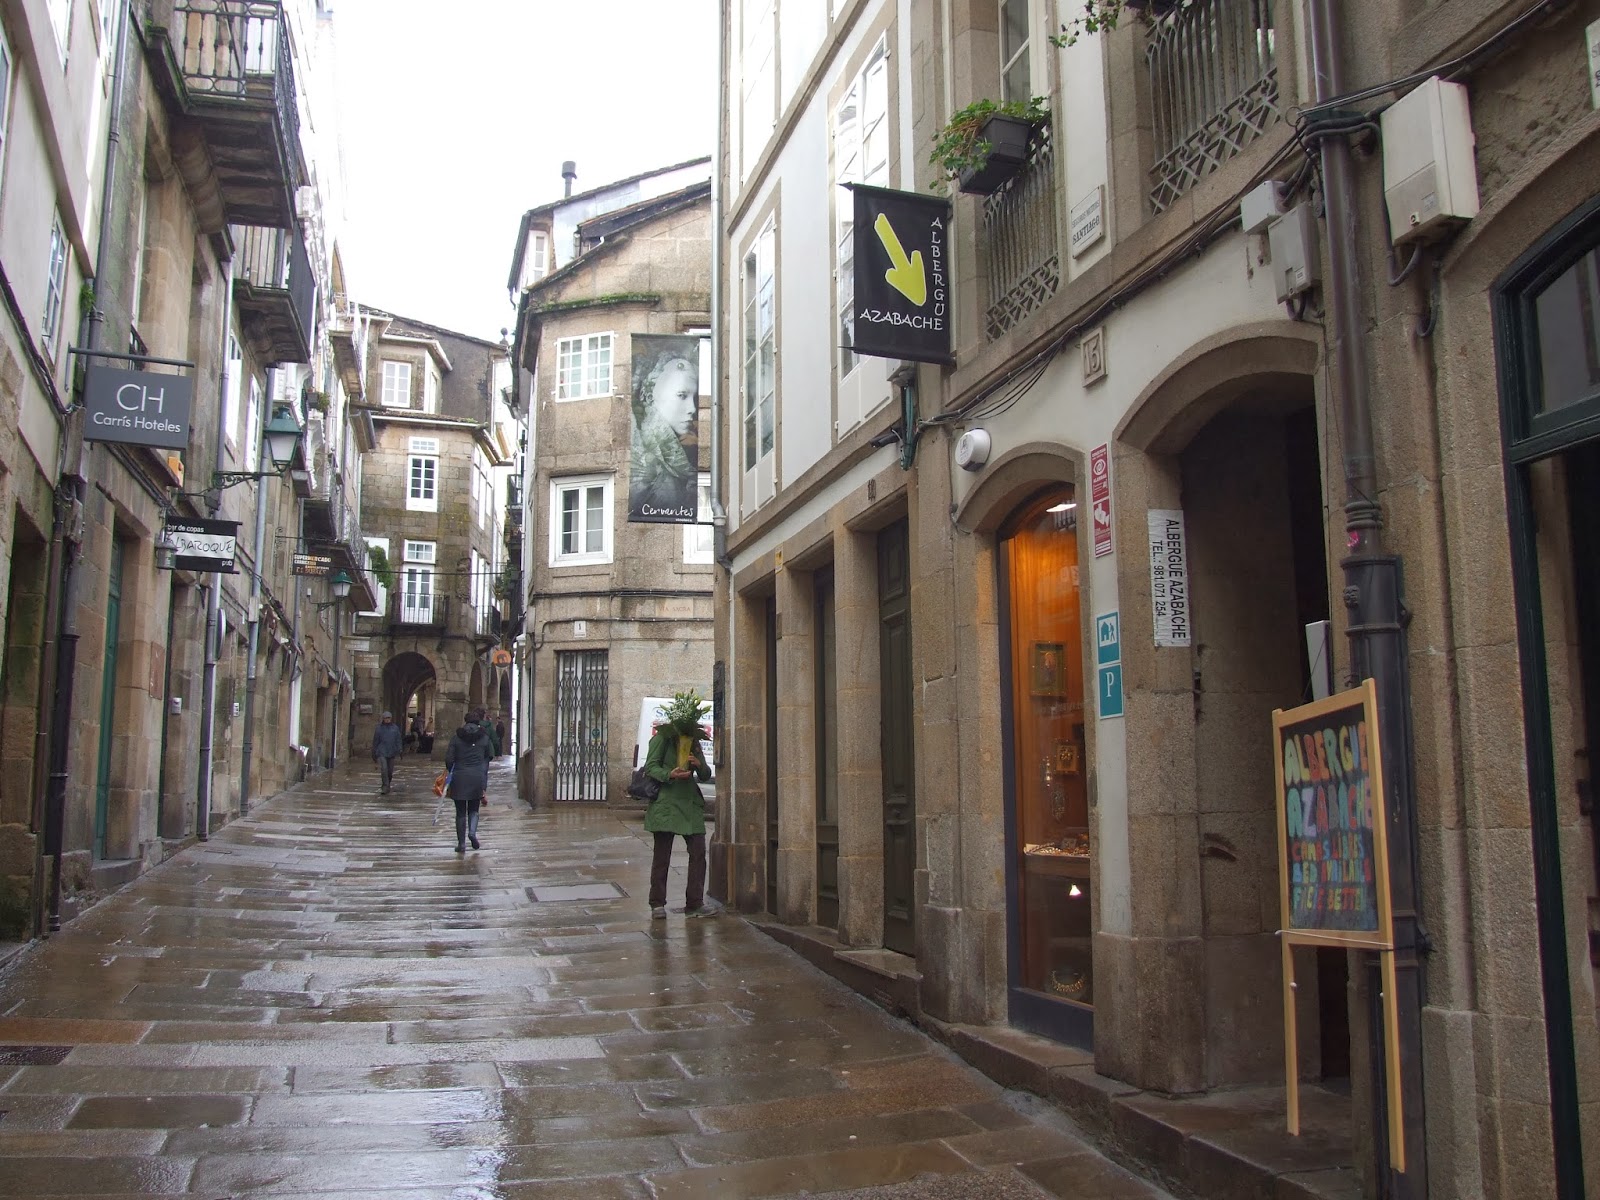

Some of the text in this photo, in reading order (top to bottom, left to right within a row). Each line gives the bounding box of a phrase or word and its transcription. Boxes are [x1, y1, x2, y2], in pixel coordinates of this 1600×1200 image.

[1072, 215, 1100, 245] SANTIAGO
[930, 216, 945, 331] ALBERGUE
[859, 308, 944, 331] AZABACHE
[1084, 335, 1101, 375] 15
[116, 383, 165, 414] CH
[93, 412, 181, 433] Carrís Hoteles
[1153, 565, 1165, 581] 981
[1165, 518, 1186, 639] ALBERGUE AZABACHE
[1154, 584, 1166, 598] 071
[1155, 601, 1167, 617] 254
[1106, 671, 1115, 697] P
[1285, 721, 1369, 786] ALBERGUE
